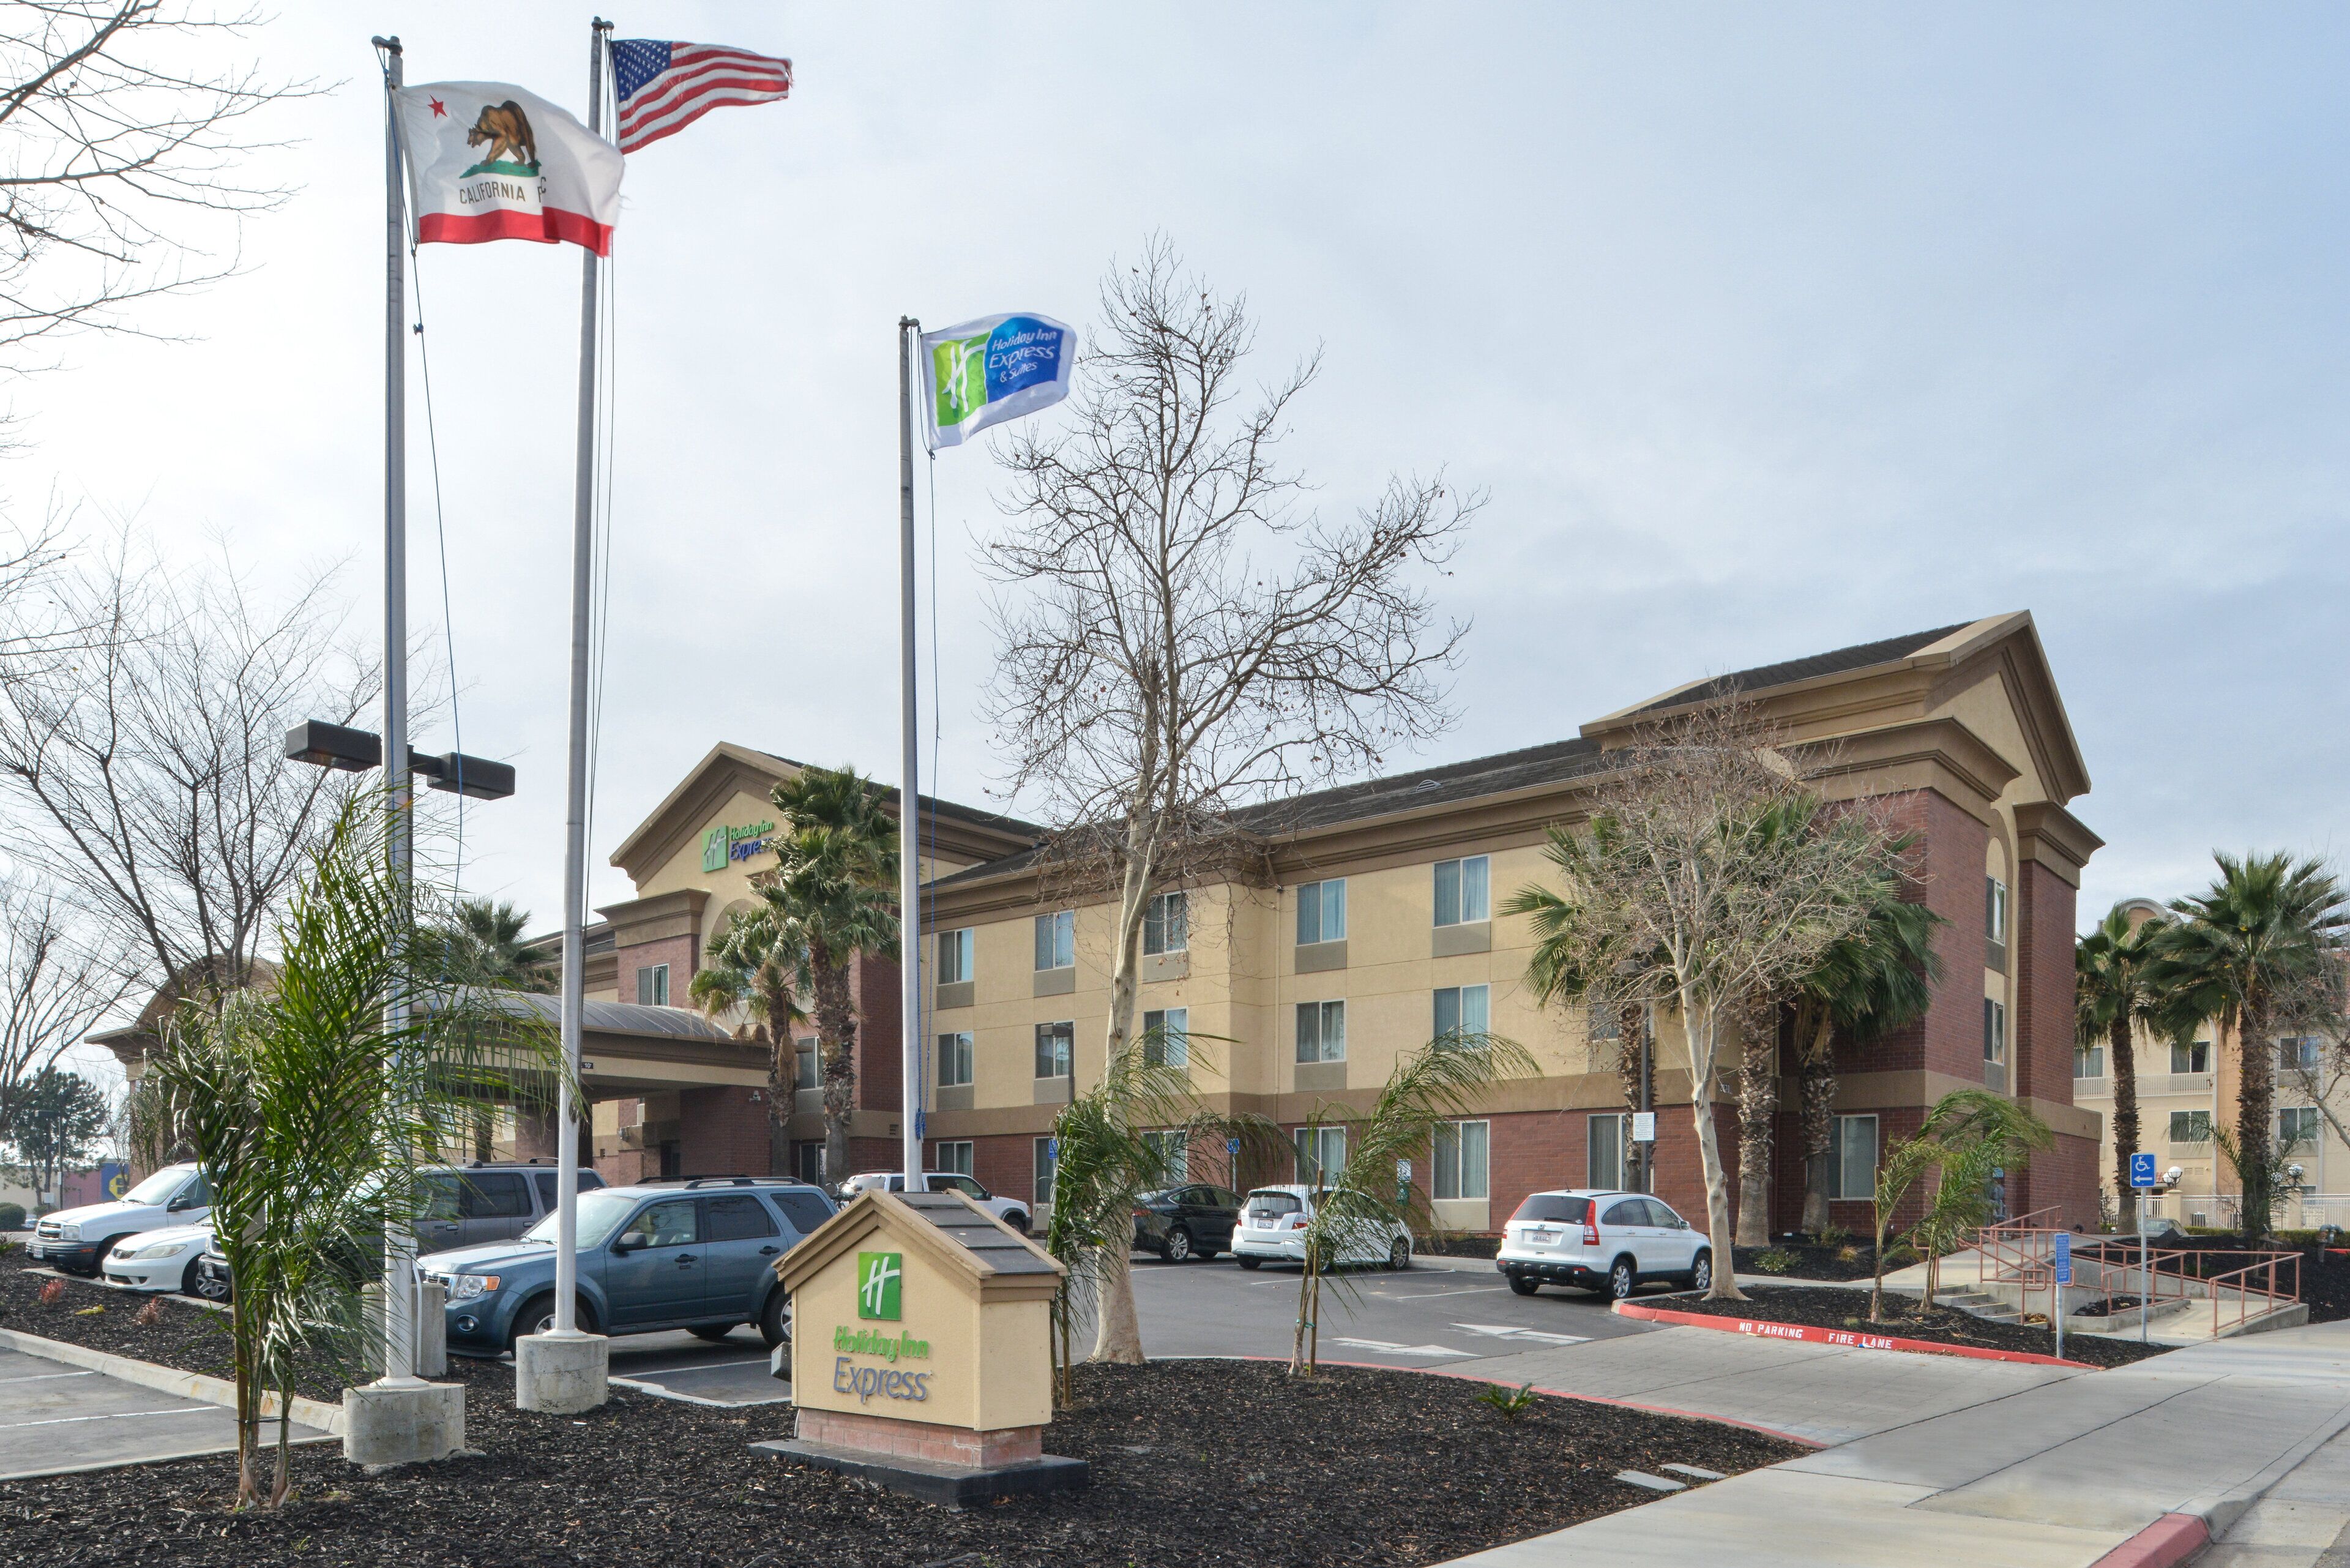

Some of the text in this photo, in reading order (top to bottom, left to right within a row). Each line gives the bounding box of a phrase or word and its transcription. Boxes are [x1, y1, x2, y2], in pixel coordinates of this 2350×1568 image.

[460, 182, 526, 204] CALIFORNIA
[992, 329, 1057, 351] Holiday Inn
[989, 346, 1055, 369] Express
[1000, 362, 1038, 383] & Suites
[729, 819, 774, 841] Holiday Inn
[1739, 1322, 1804, 1338] NO PARKING
[1828, 1333, 1893, 1349] FIRE LANE
[834, 1325, 928, 1362] Holiday Inn
[834, 1356, 928, 1405] Express
